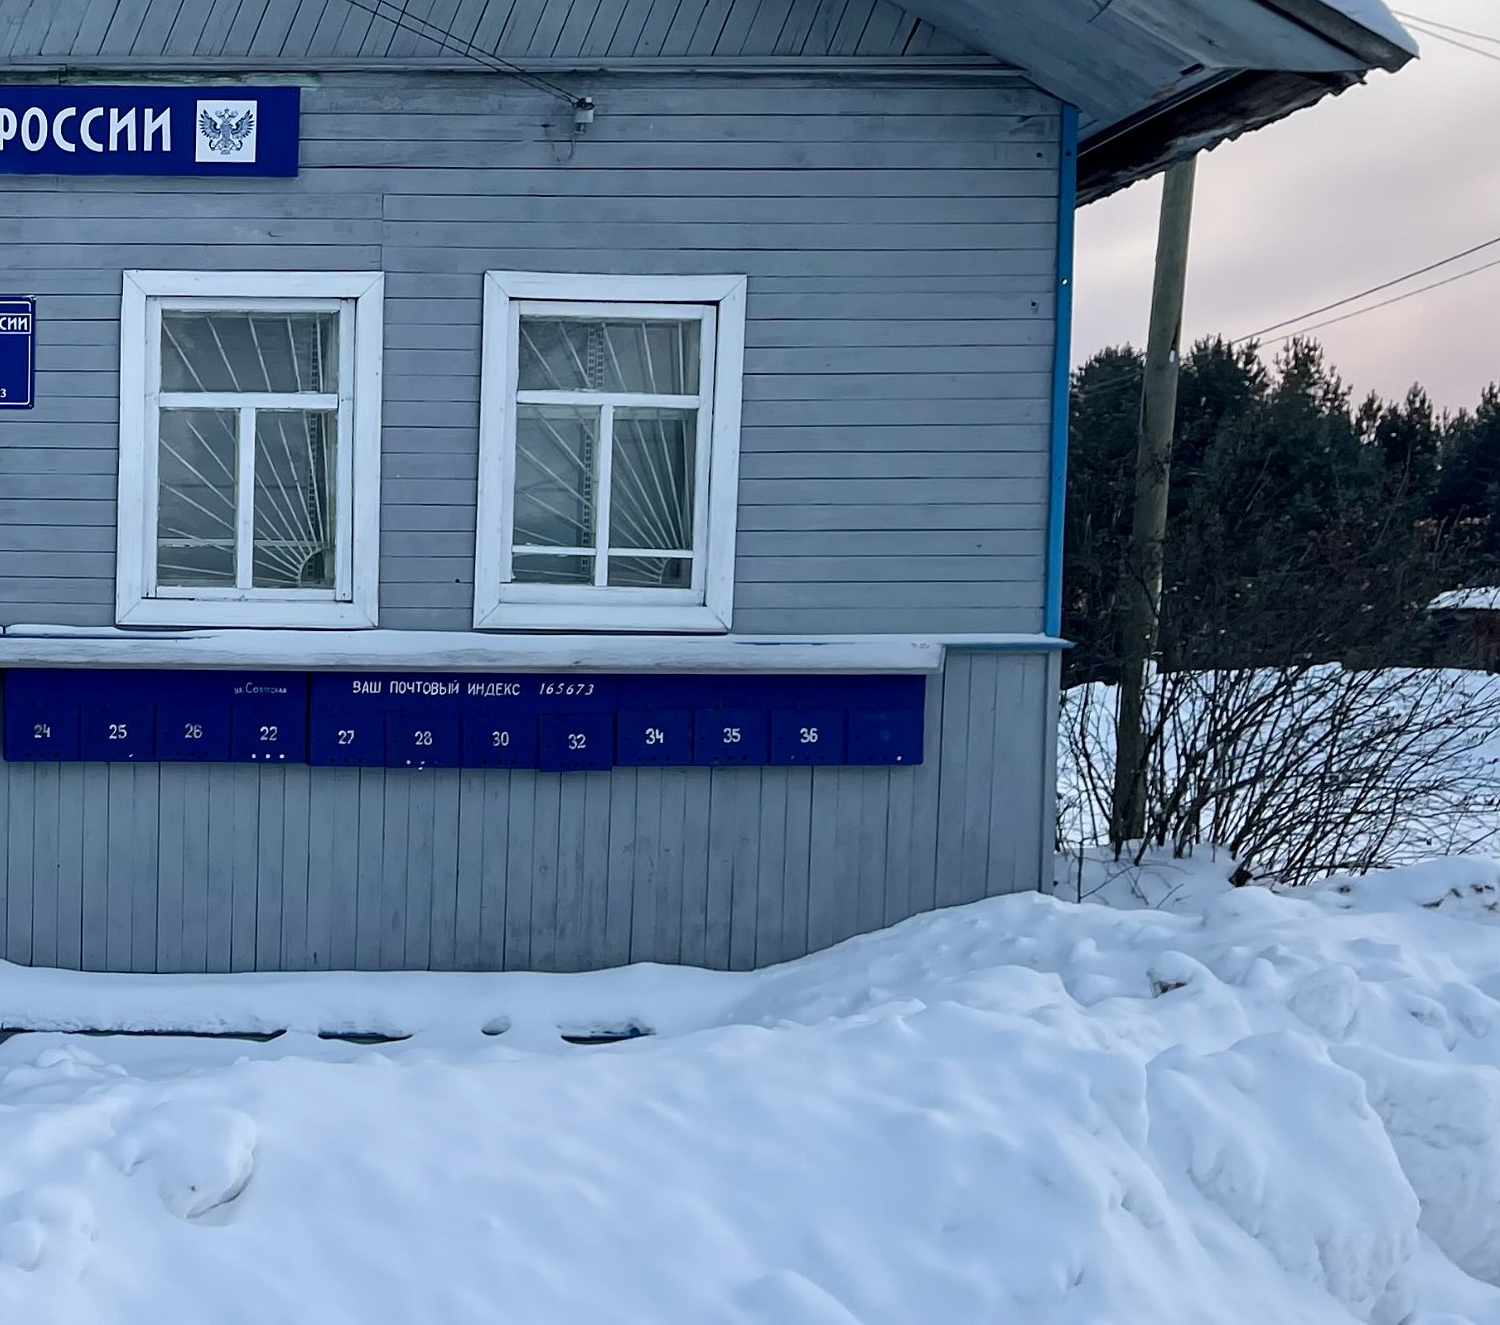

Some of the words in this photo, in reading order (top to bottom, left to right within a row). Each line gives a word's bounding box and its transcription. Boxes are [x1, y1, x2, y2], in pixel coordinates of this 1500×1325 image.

[352, 680, 382, 694] ВАШ
[389, 679, 460, 696] ПОЧТОВЫЙ
[467, 682, 521, 697] ИНДЕКС
[538, 682, 595, 696] 165673
[33, 723, 51, 739] 24
[108, 723, 128, 740] 25
[183, 723, 203, 740] 26
[259, 725, 278, 742] 22
[337, 729, 355, 745] 27
[413, 730, 433, 747] 28
[491, 730, 510, 747] 30
[644, 727, 665, 745] 34
[722, 727, 742, 744] 35
[799, 727, 819, 745] 36
[567, 733, 587, 750] 32
